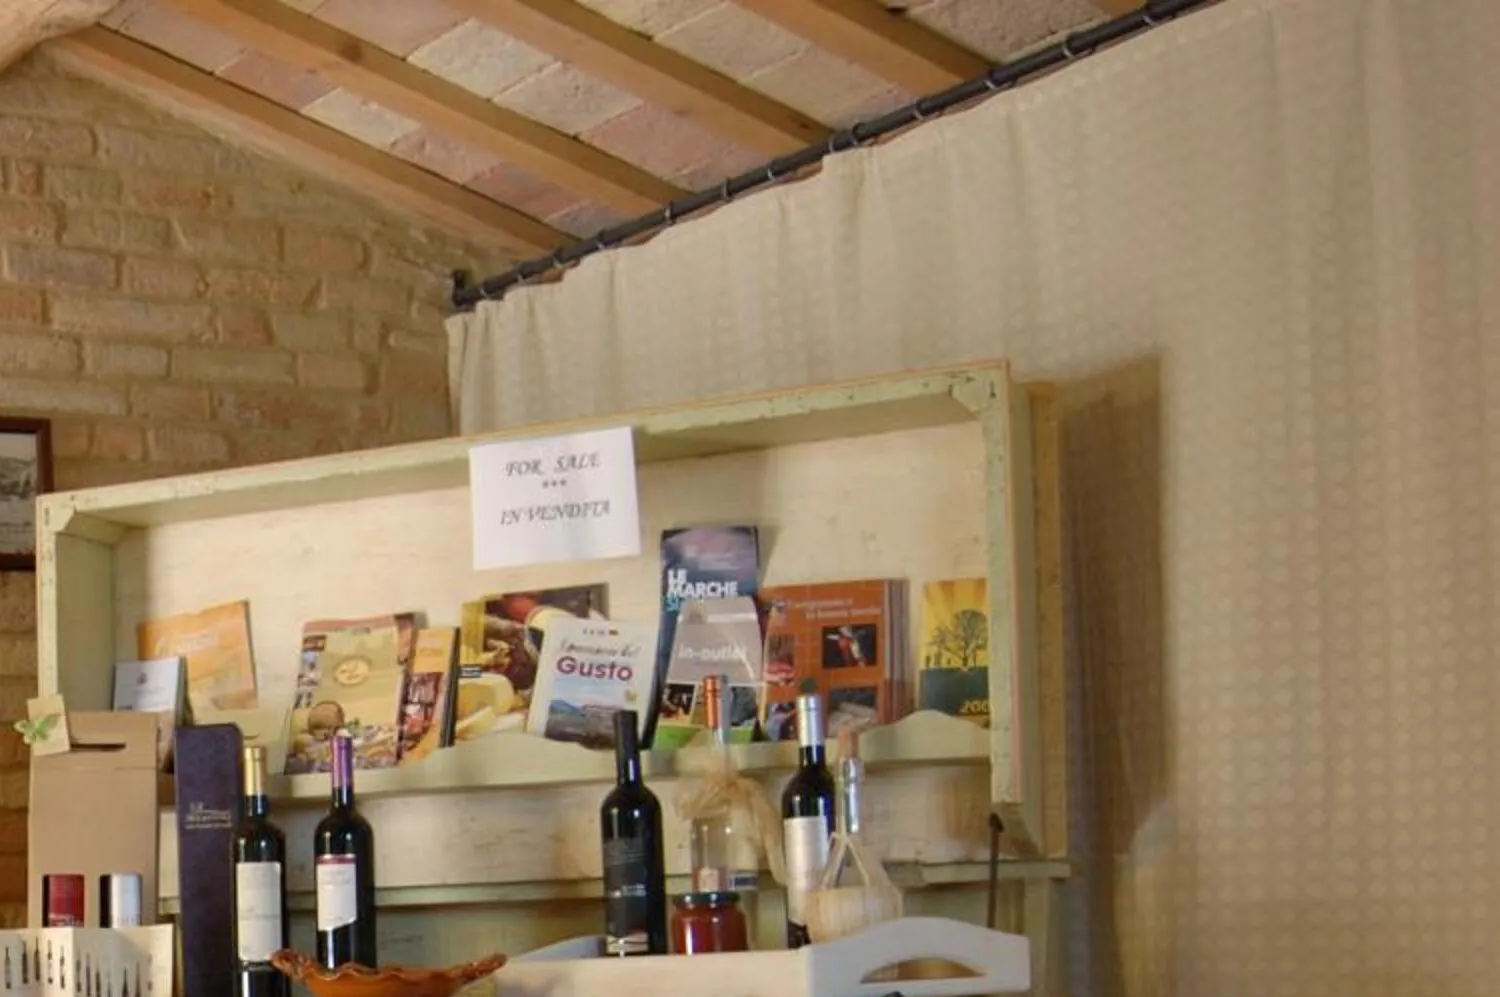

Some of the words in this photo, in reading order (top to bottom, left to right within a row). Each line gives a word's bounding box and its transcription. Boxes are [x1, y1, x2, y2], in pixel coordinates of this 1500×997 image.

[505, 458, 543, 477] FOR
[554, 452, 600, 473] SALE
[500, 509, 522, 526] IN
[525, 500, 611, 522] VENDITA
[667, 568, 688, 582] LE
[667, 581, 739, 597] MARCHE
[556, 655, 633, 682] Gusto
